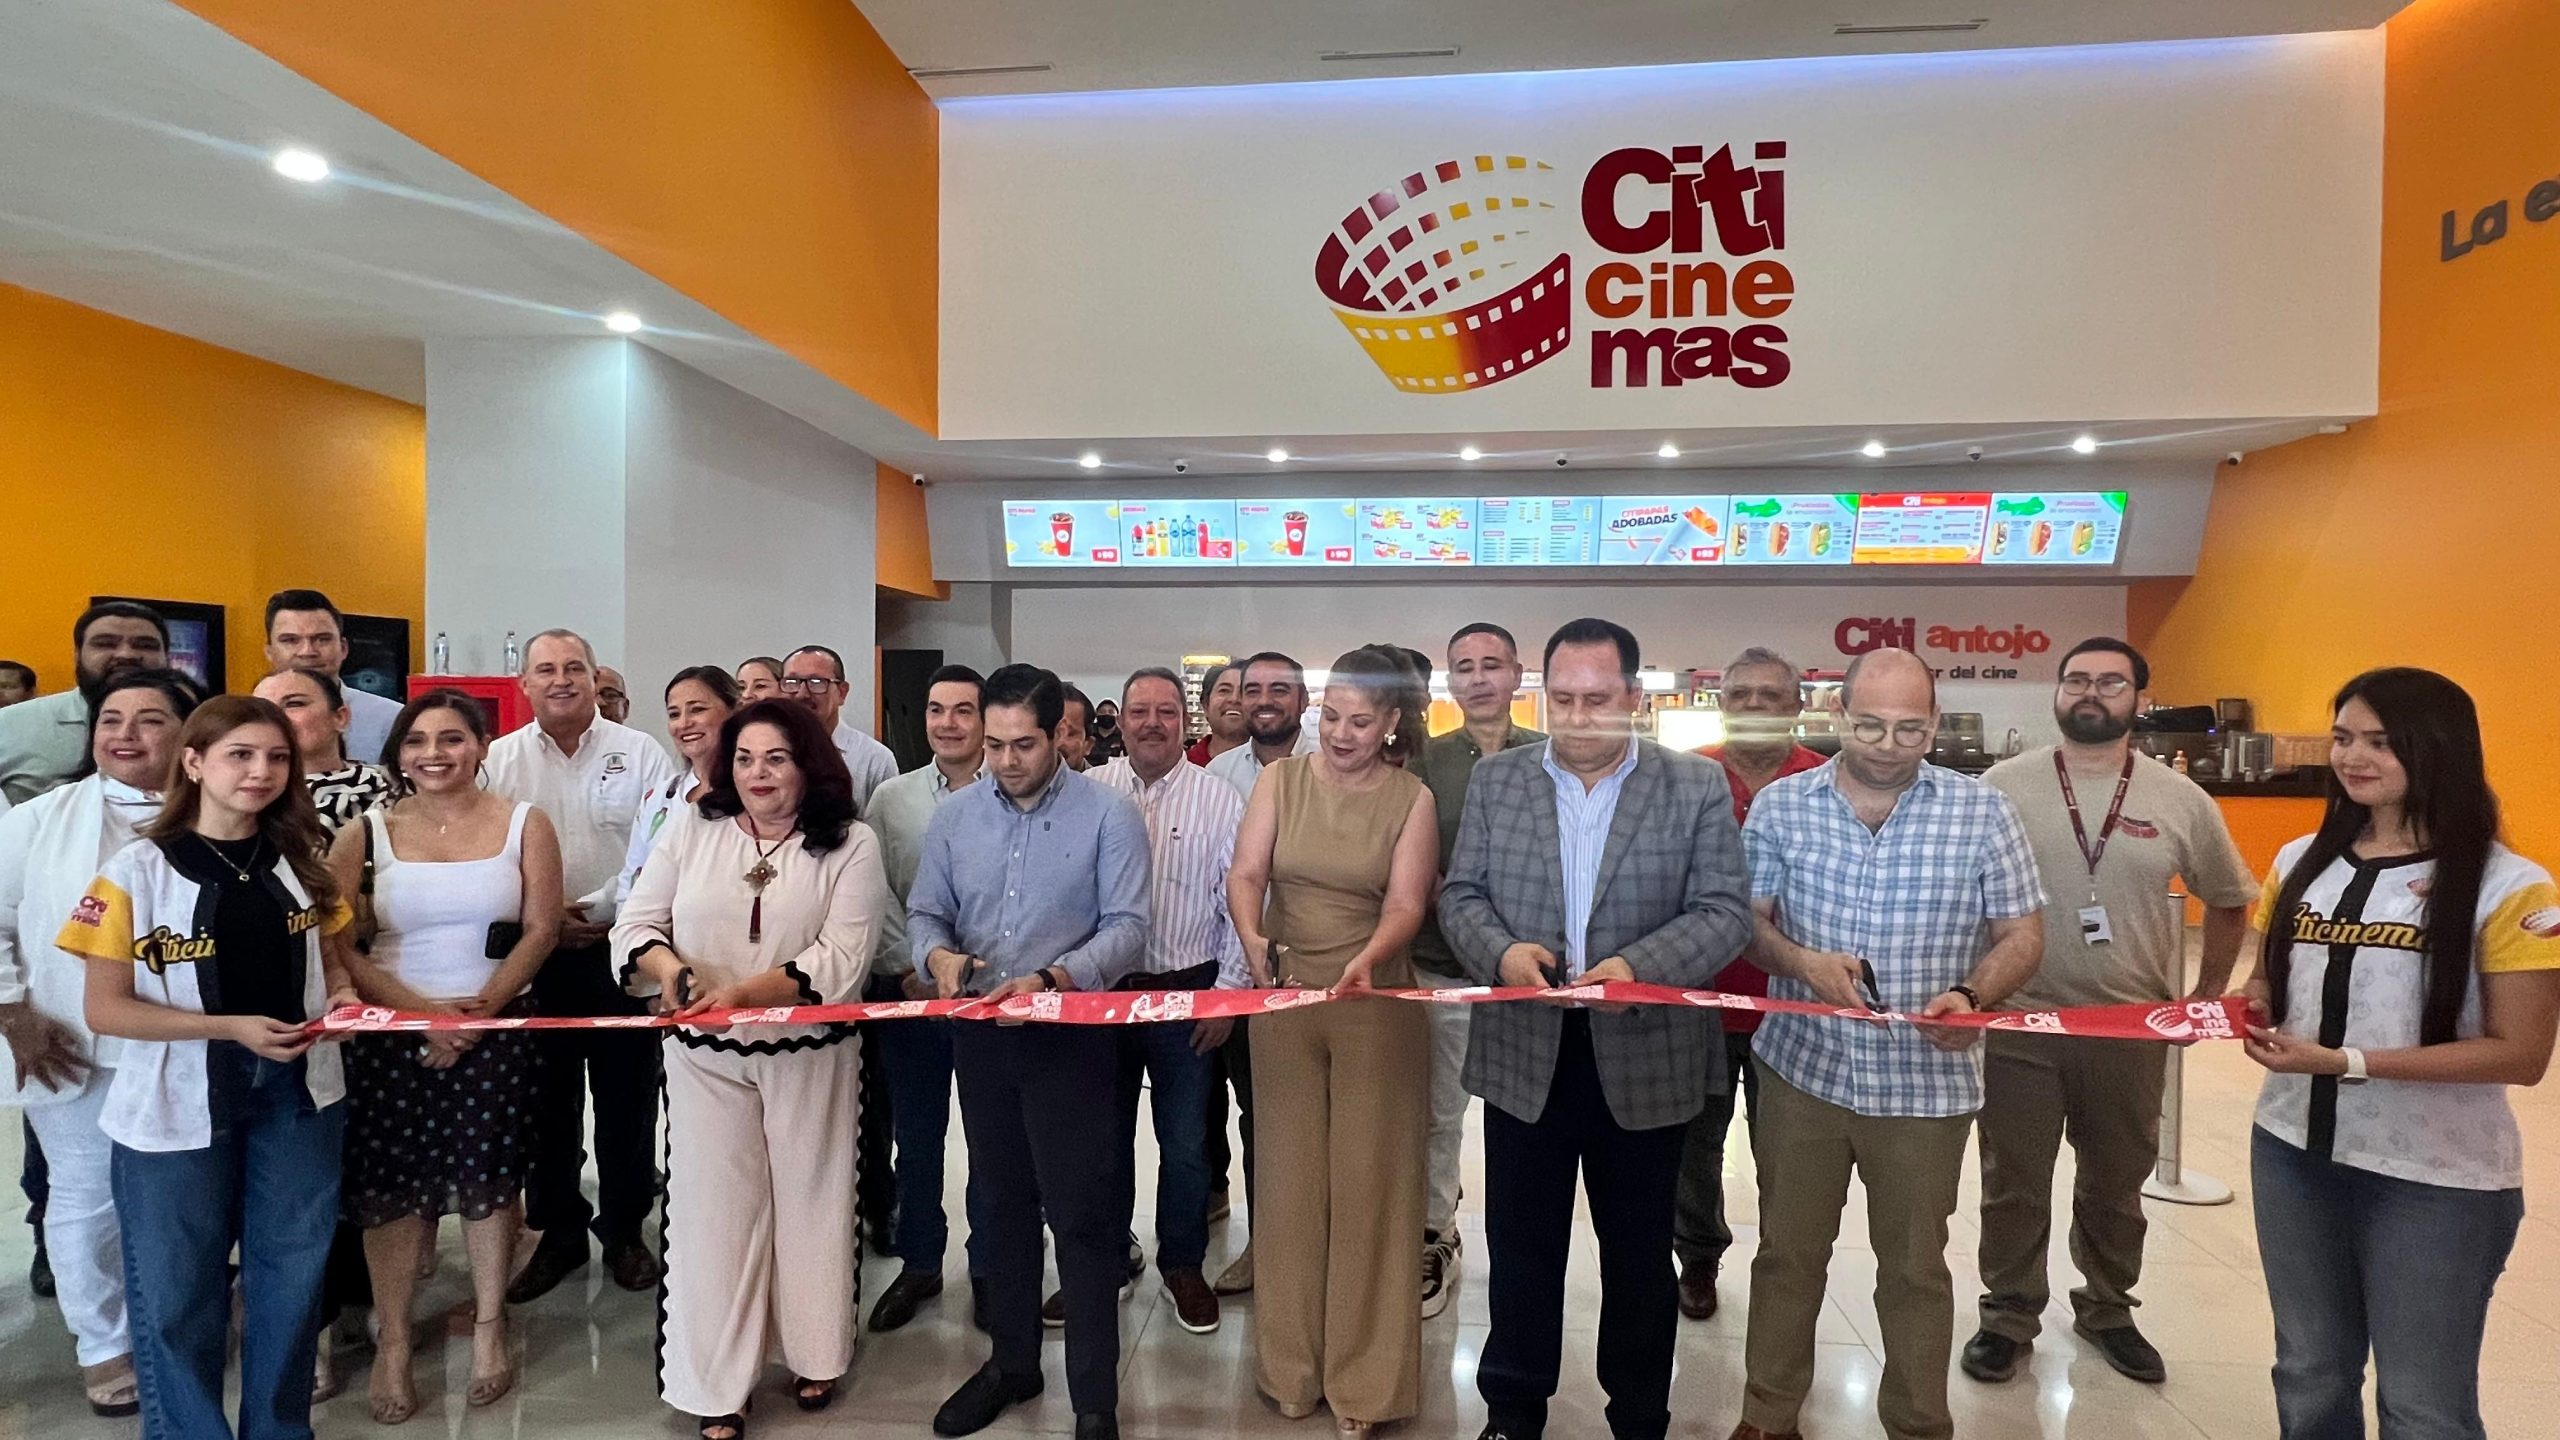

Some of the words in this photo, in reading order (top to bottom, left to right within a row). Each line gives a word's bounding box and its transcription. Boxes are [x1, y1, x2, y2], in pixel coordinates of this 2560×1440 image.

[1581, 141, 1787, 257] Citi
[2441, 199, 2508, 262] La
[2524, 180, 2560, 222] e
[1585, 260, 1795, 319] cine
[1591, 324, 1791, 388] mas
[1611, 513, 1678, 528] ADOBADAS
[1834, 617, 1916, 656] Citi
[1926, 624, 2050, 659] antojo
[1949, 665, 1976, 679] del
[1981, 665, 2018, 679] cine
